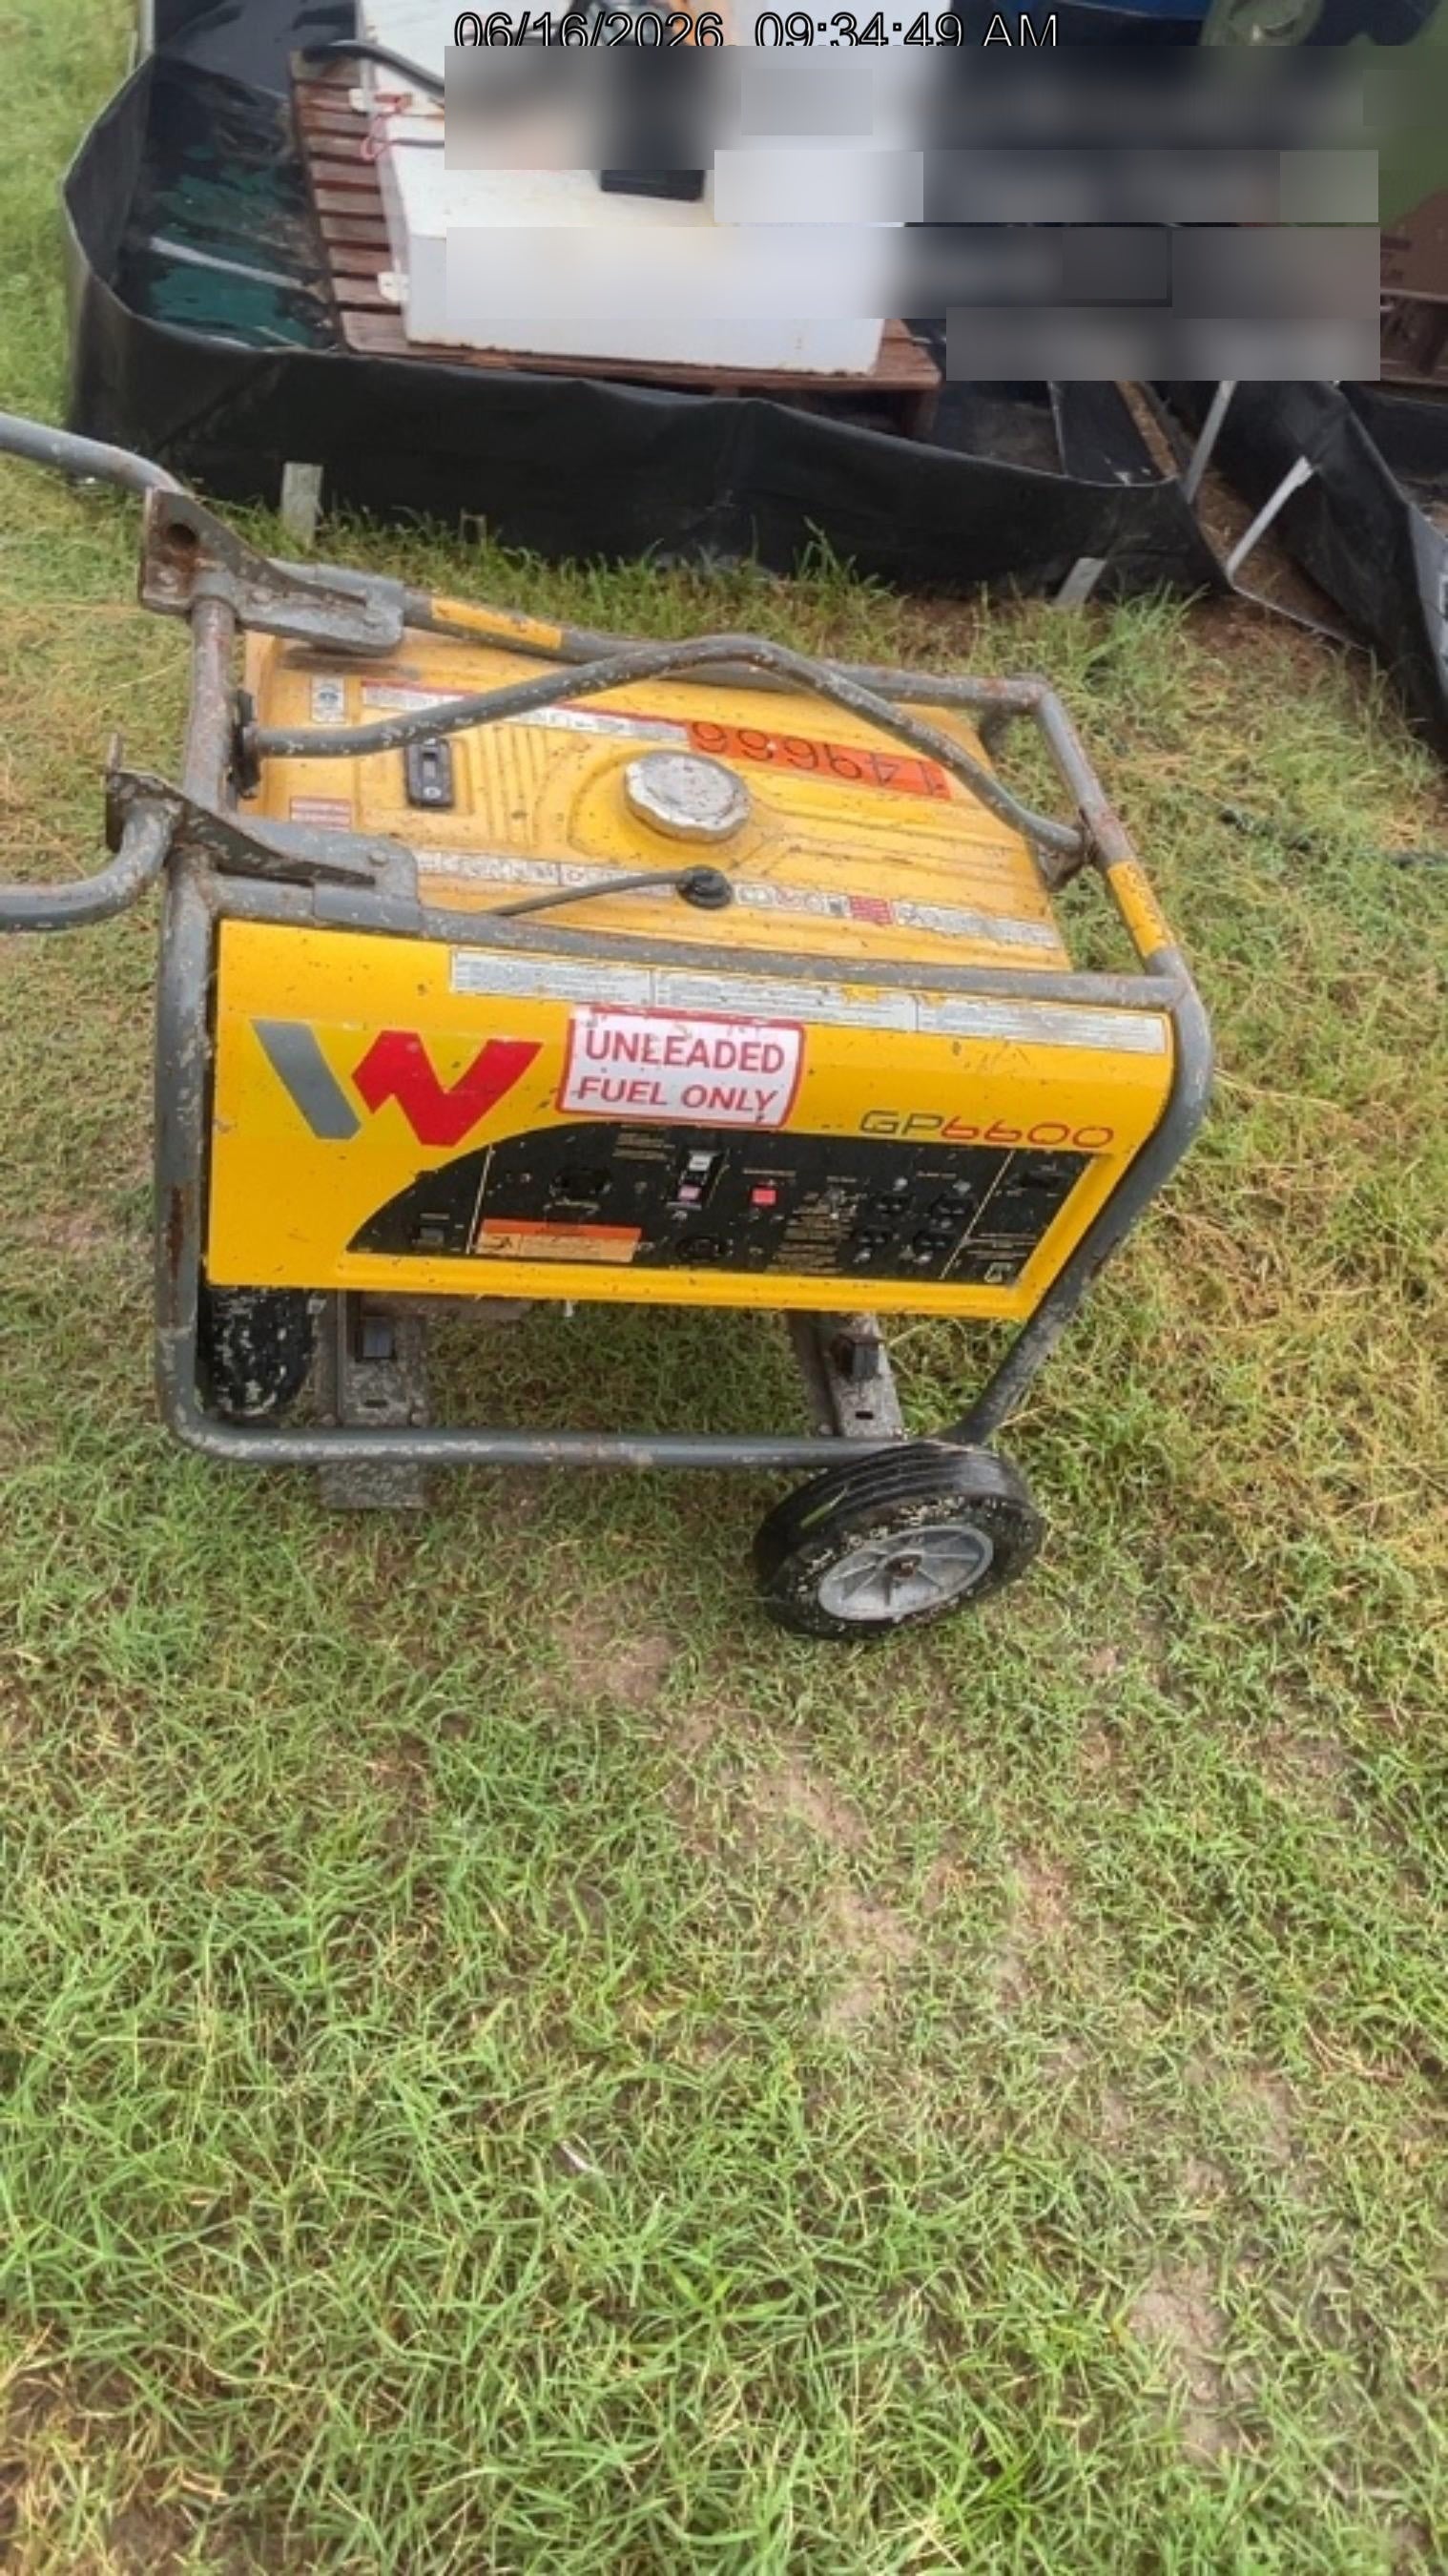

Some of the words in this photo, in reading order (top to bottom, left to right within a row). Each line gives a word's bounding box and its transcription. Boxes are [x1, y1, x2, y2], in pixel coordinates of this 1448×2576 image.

[585, 1028, 785, 1075] UNLEADED
[576, 1075, 668, 1107] FUEL
[680, 1083, 779, 1114] ONLY
[859, 1109, 1115, 1150] GP6600
